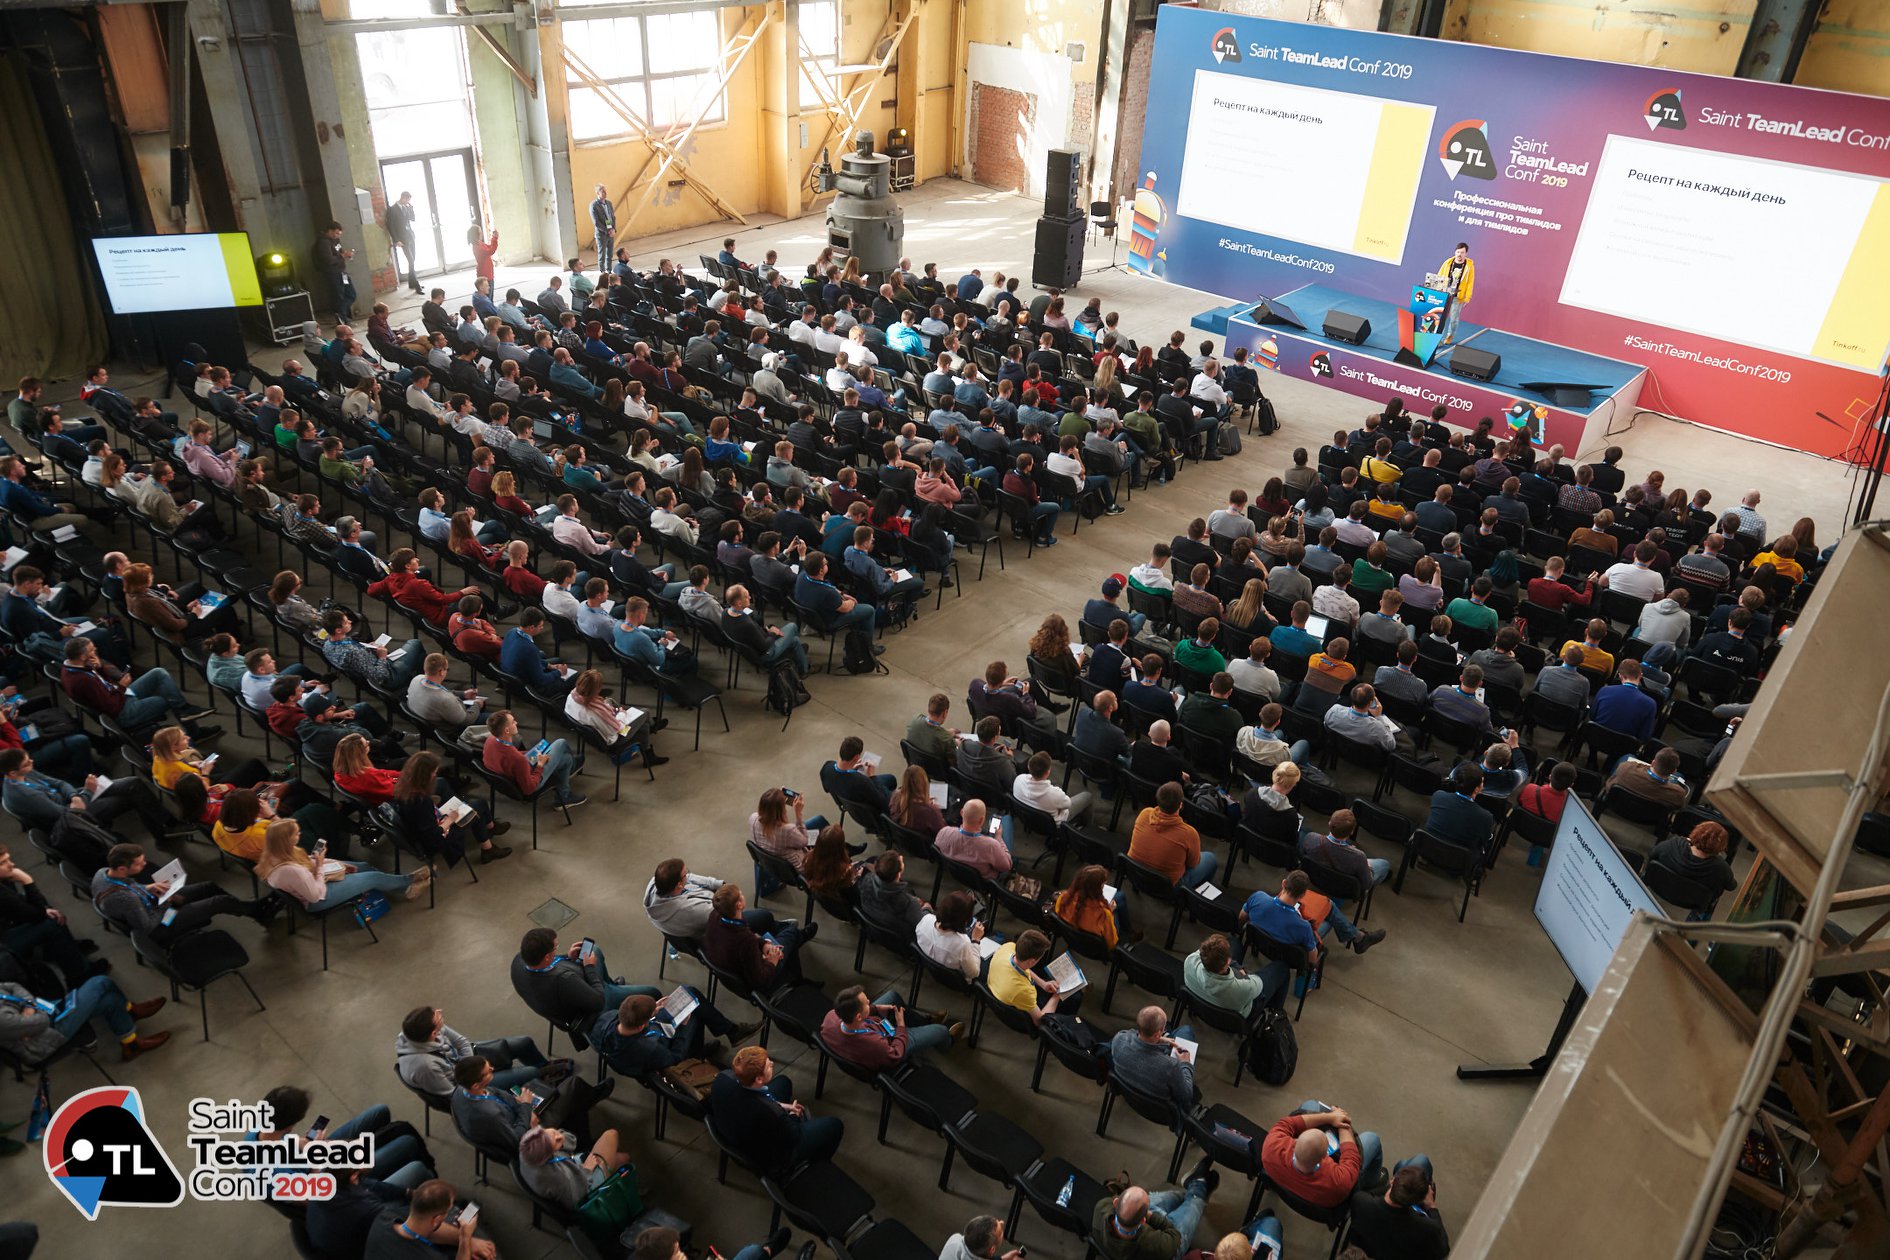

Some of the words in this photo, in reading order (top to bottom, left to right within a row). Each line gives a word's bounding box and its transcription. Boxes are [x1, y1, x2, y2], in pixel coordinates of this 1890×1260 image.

[1224, 44, 1237, 56] TL
[1250, 43, 1278, 61] Saint
[1281, 47, 1347, 70] TeamLead
[1349, 58, 1380, 76] Conf
[1382, 62, 1413, 79] 2019
[1662, 107, 1679, 122] TL
[1698, 107, 1742, 128] Saint
[1747, 113, 1846, 143] TeamLead
[1465, 148, 1487, 168] TL
[1512, 136, 1549, 154] Saint
[1505, 165, 1540, 182] Conf
[1541, 174, 1568, 188] 2019
[1510, 150, 1589, 176] TeamLead
[1628, 168, 1675, 185] Рецепт
[1676, 179, 1692, 188] на
[1694, 182, 1750, 199] каждый
[1751, 192, 1786, 205] день
[1434, 199, 1494, 218] конференция
[1496, 211, 1513, 222] про
[1516, 216, 1561, 231] тимлидов
[1454, 190, 1543, 216] Профессиональная
[1465, 217, 1482, 226] для
[1484, 220, 1528, 235] тимлидов
[1218, 238, 1335, 274] #SaintTeamLeadConf2019
[1624, 335, 1791, 383] #SaintTeamLeadConf2019
[1340, 366, 1364, 381] Saint
[1366, 372, 1421, 397] TeamLead
[1421, 389, 1448, 405] Conf
[1448, 396, 1473, 412] 2019
[1573, 826, 1596, 860] Рецепт
[1595, 858, 1604, 872] на
[1603, 870, 1632, 910] каждый
